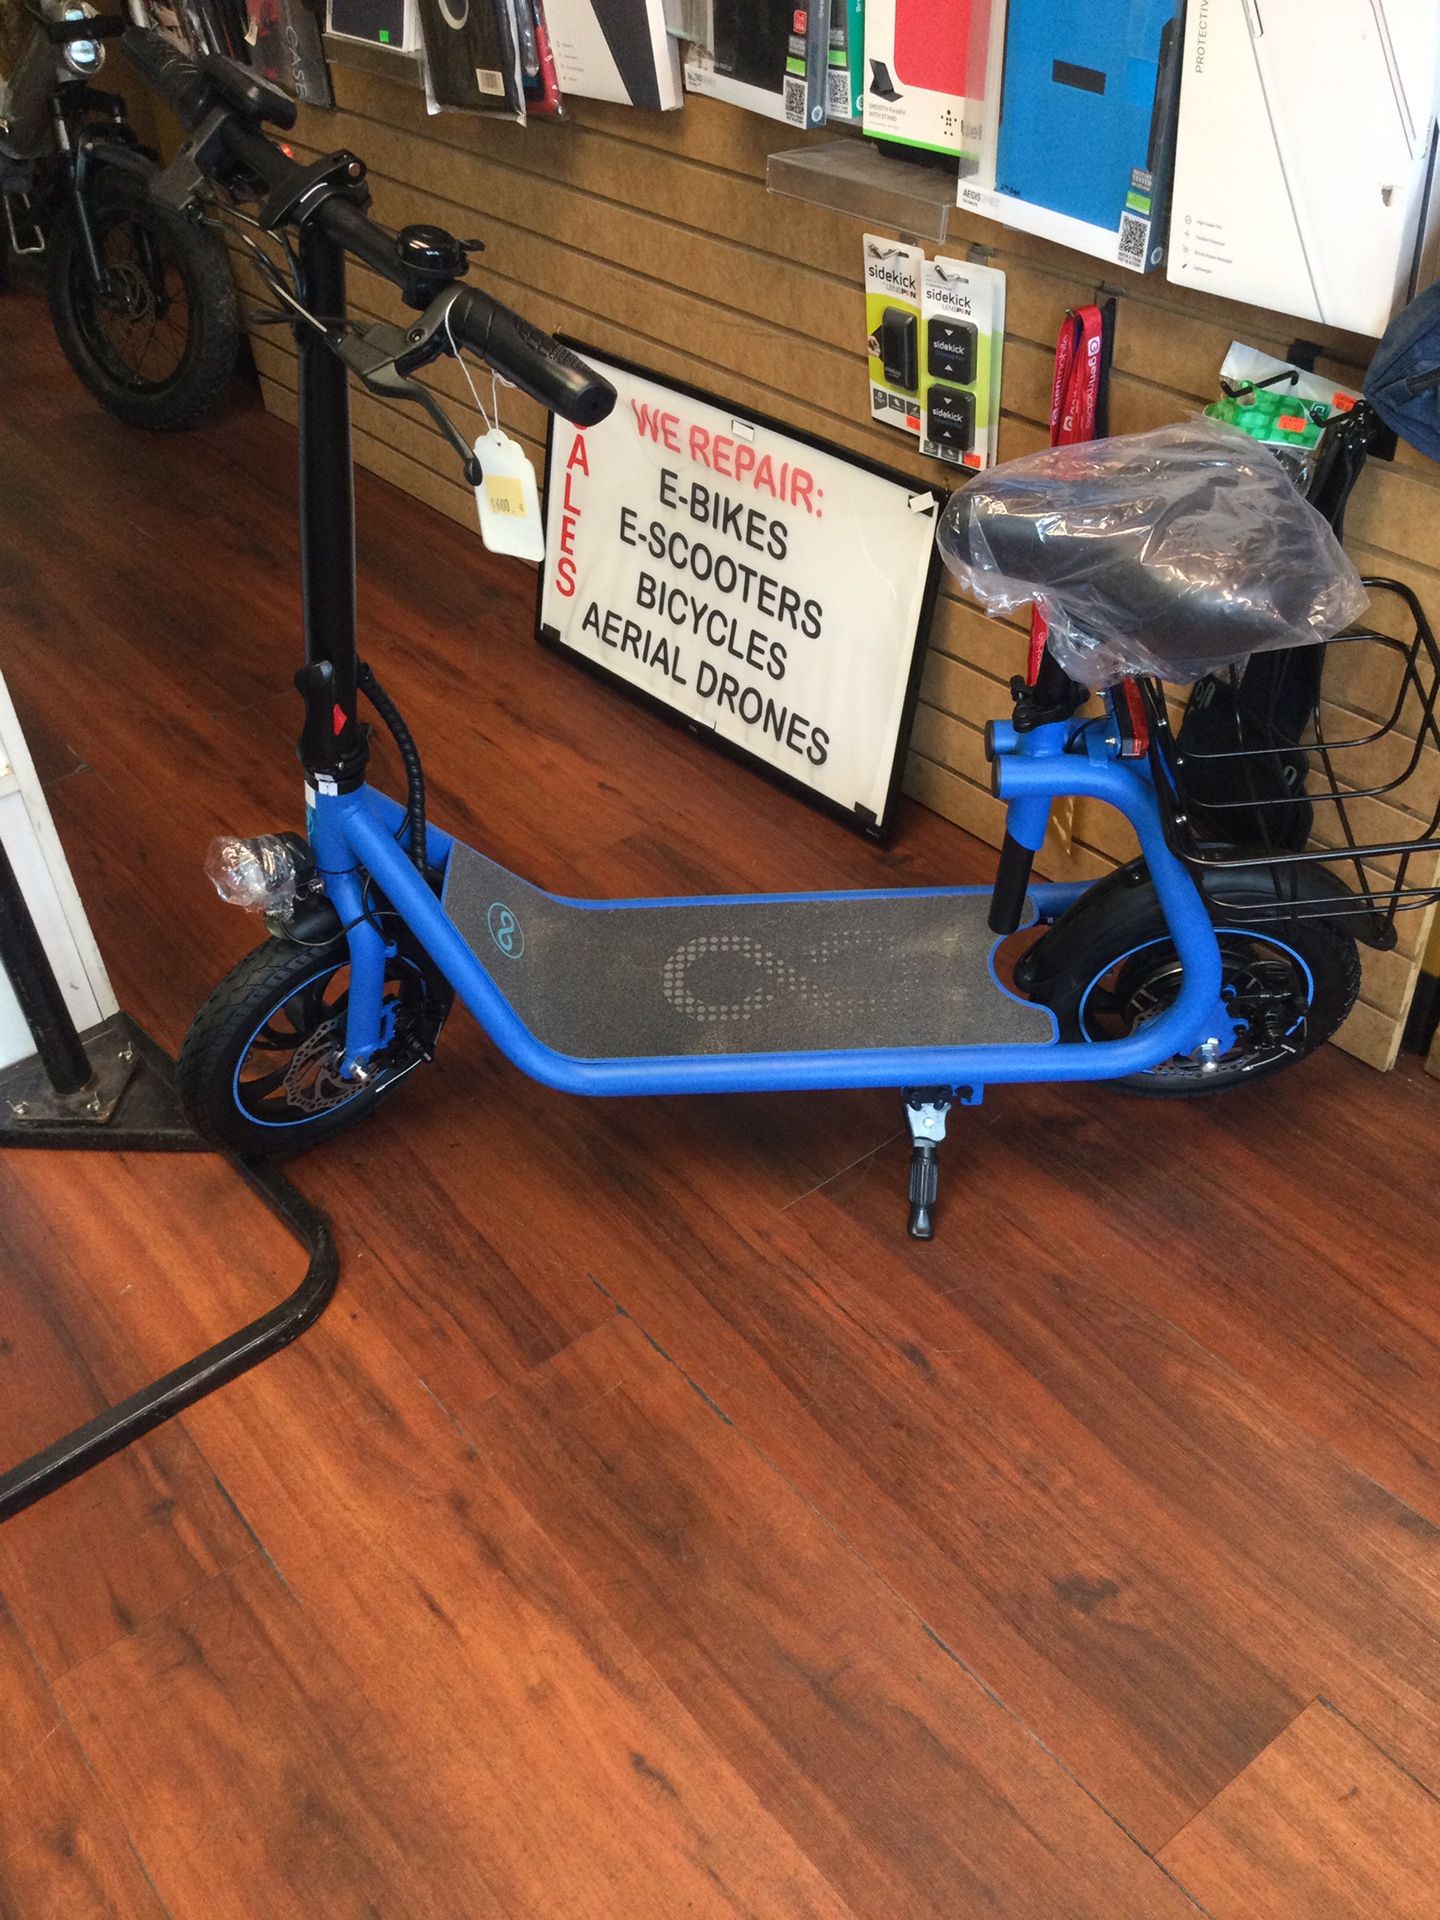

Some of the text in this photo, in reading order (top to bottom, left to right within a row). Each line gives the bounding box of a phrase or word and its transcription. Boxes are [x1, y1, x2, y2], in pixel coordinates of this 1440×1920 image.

[868, 264, 917, 290] sidekick
[926, 288, 971, 309] sidekick
[933, 340, 965, 355] sidekick
[631, 398, 824, 518] WE REPAIR:
[932, 407, 963, 423] sidekick
[556, 423, 590, 598] ALES
[659, 467, 788, 561] E-BIKES
[619, 506, 823, 640] E-SCOOTERS
[636, 571, 787, 681] BICYCLES
[582, 601, 830, 766] AERIAL DRONES
